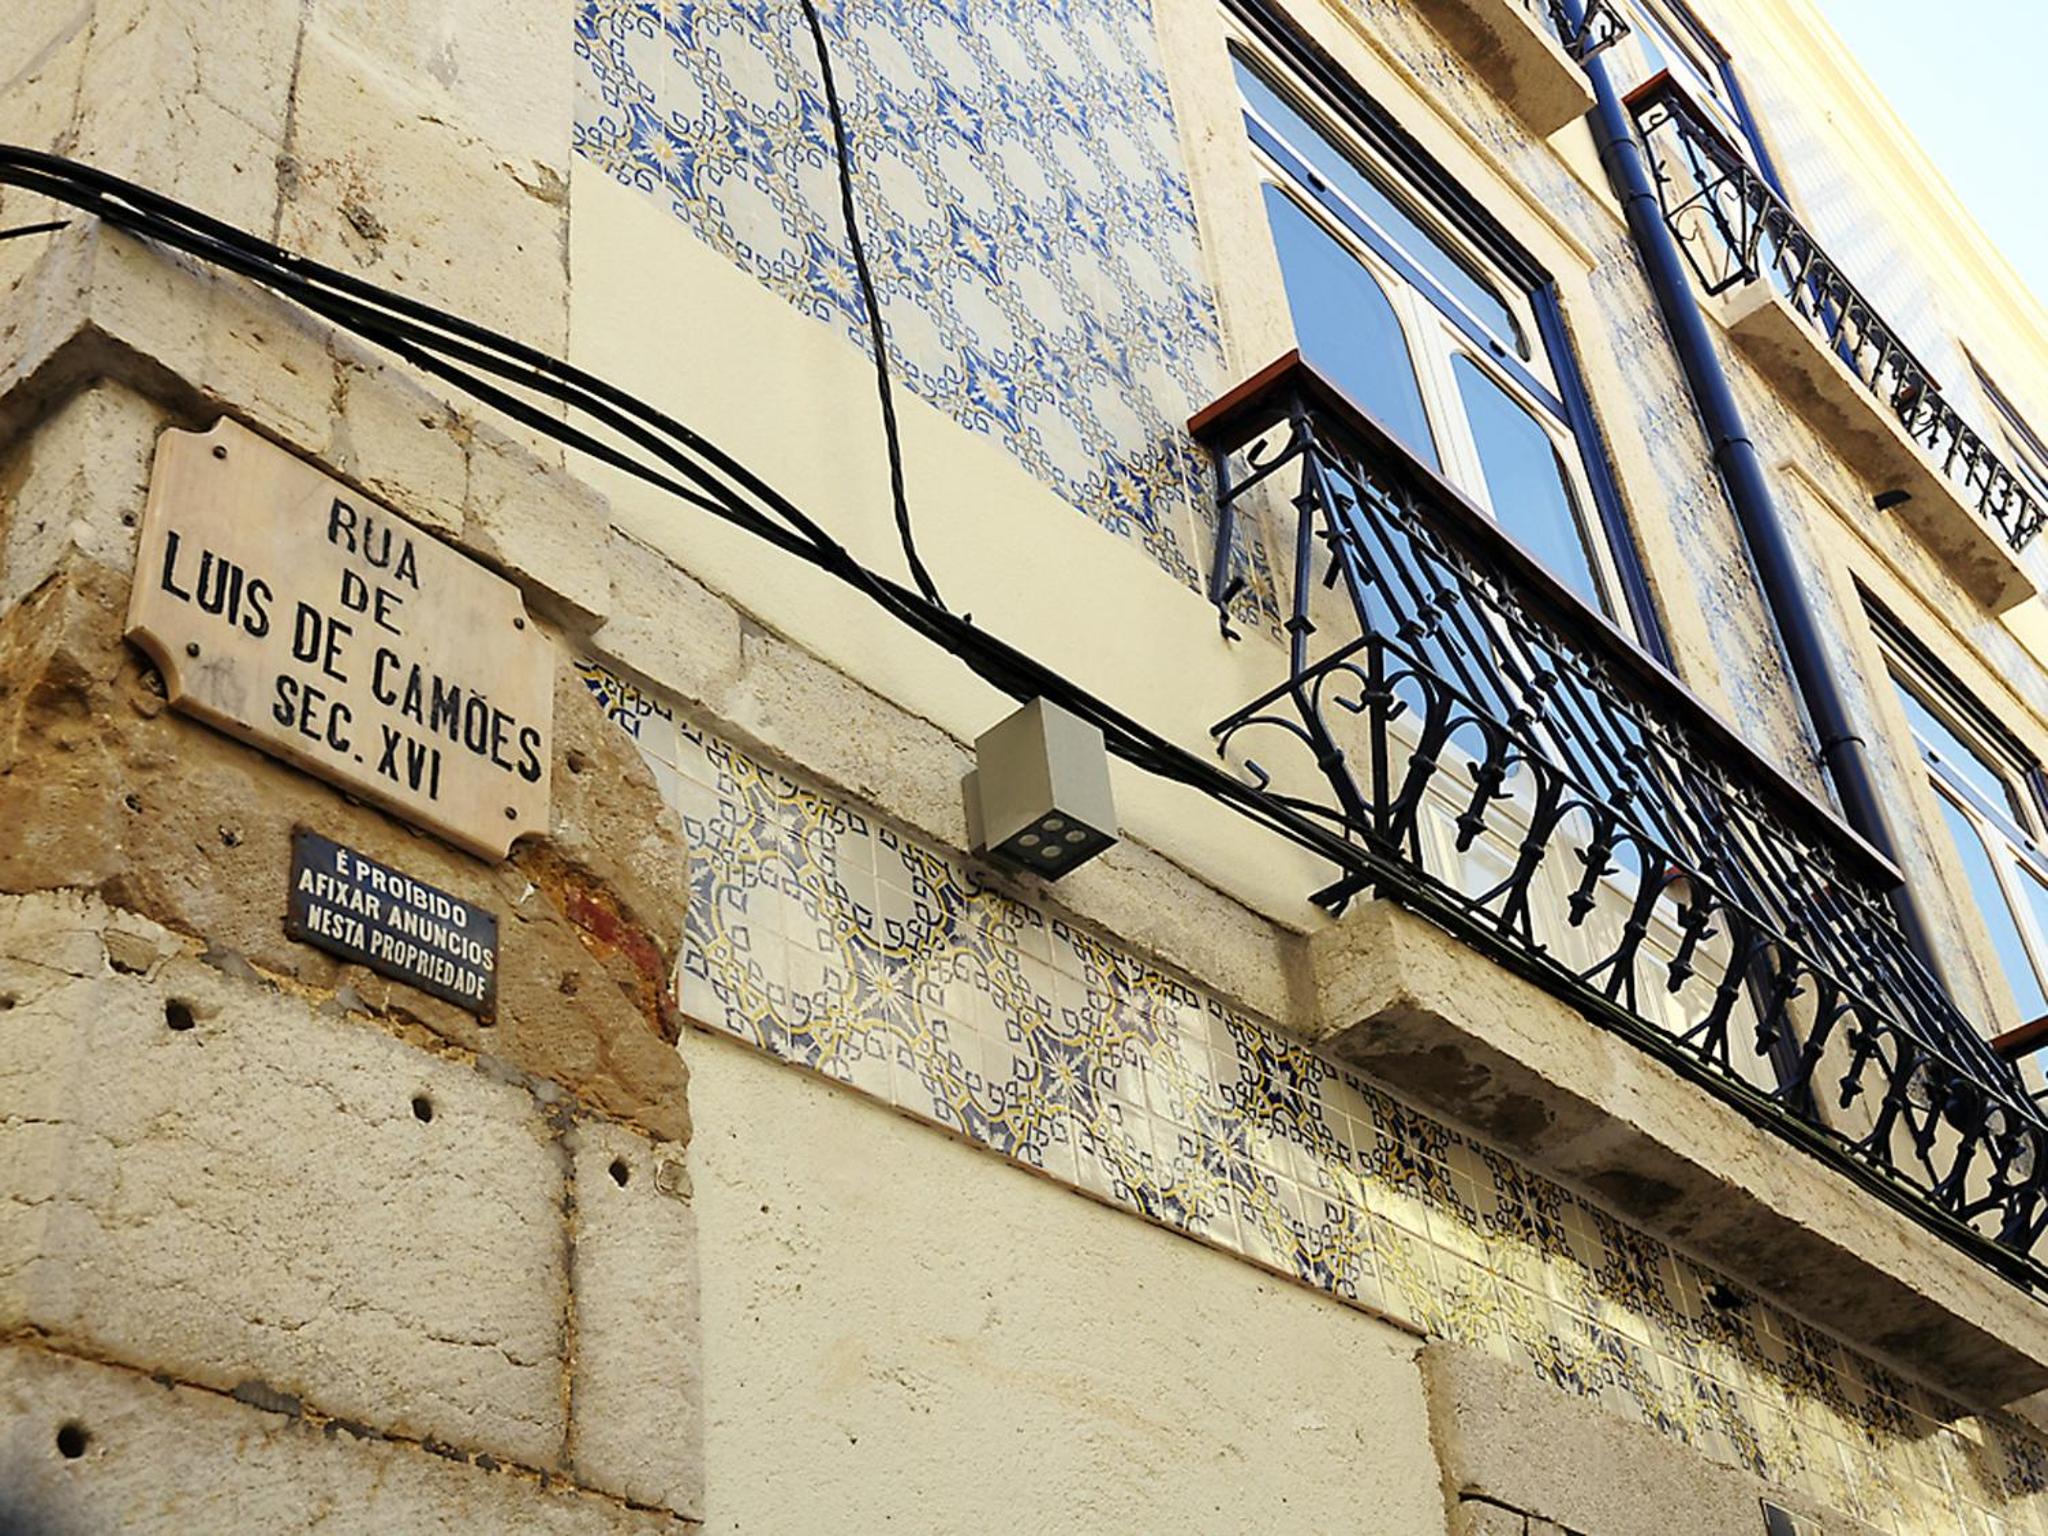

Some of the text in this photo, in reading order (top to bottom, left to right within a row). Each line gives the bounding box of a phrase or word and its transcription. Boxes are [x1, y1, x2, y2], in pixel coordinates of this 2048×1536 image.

[328, 497, 419, 590] RUA
[340, 568, 403, 635] DE
[161, 531, 542, 784] LUIS DE CAMÕES
[272, 674, 442, 801] SEC. XVI
[335, 849, 350, 876] É
[298, 868, 495, 971] AFIXAR ANUNCIOS
[307, 904, 486, 1001] NESTA PROPRIEDADE
